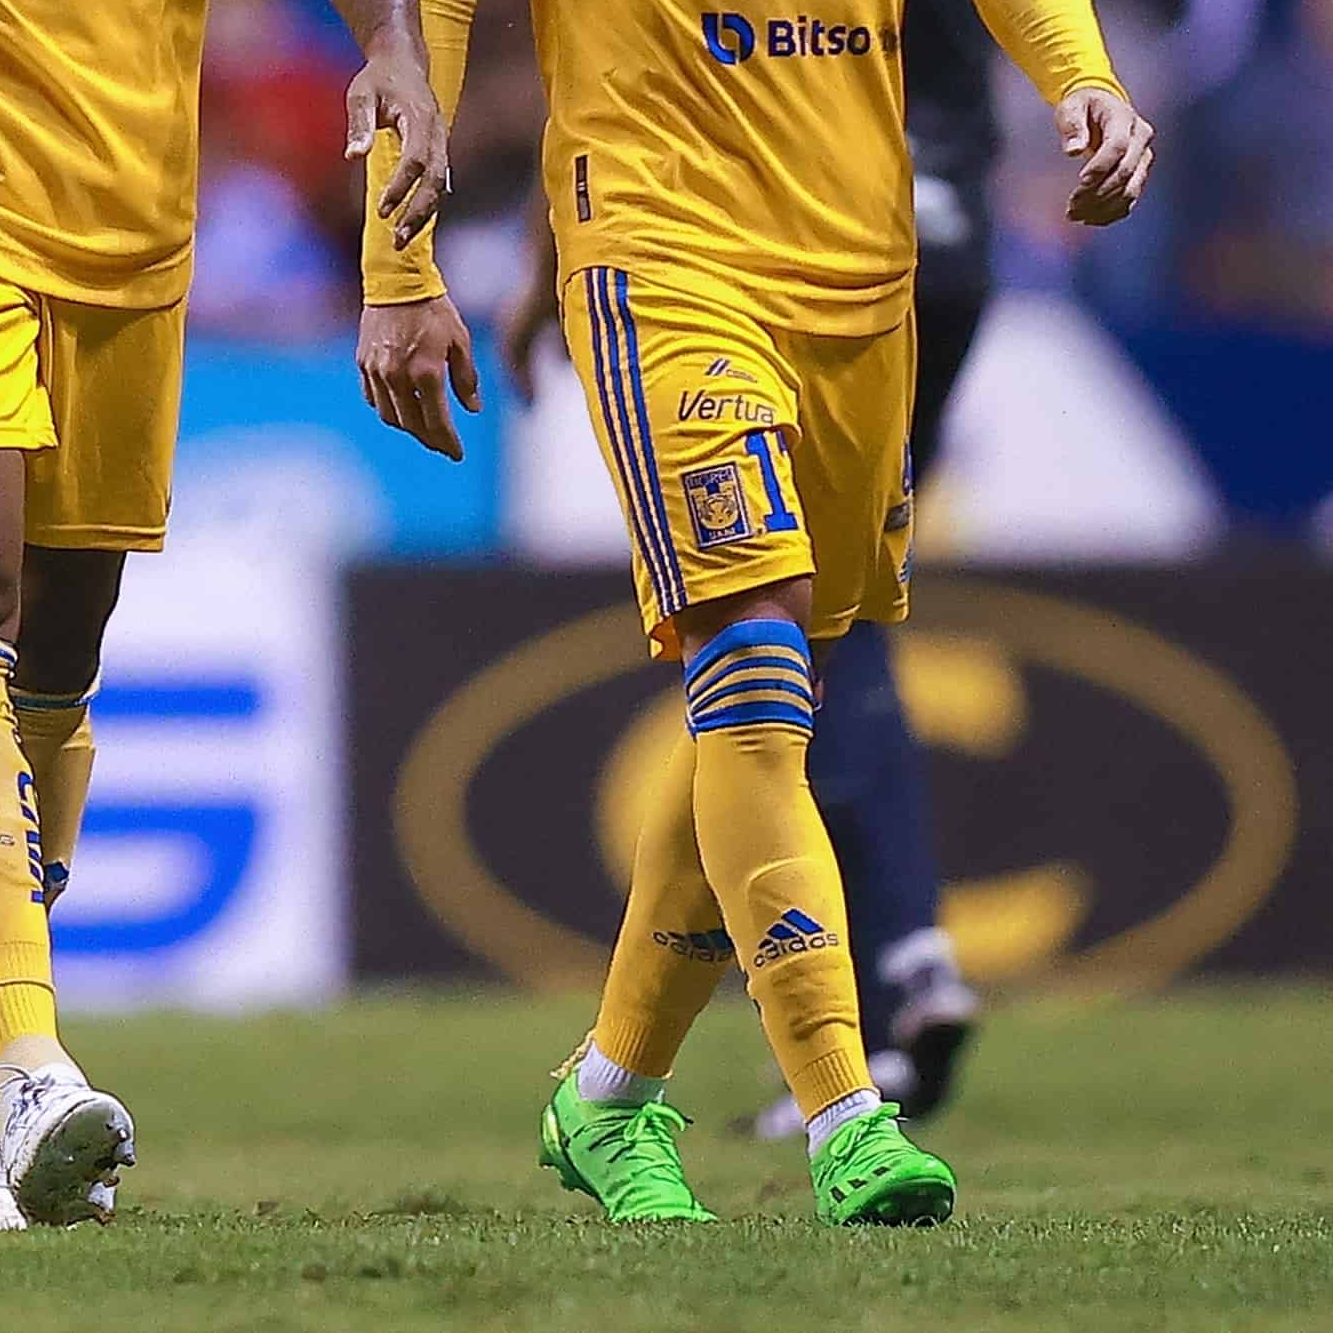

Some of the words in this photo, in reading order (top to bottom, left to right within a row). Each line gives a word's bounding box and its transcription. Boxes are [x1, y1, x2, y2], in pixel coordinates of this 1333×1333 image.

[767, 15, 873, 57] Bitso
[677, 388, 776, 426] Vertua
[744, 427, 800, 532] 1
[752, 931, 840, 969] adidas
